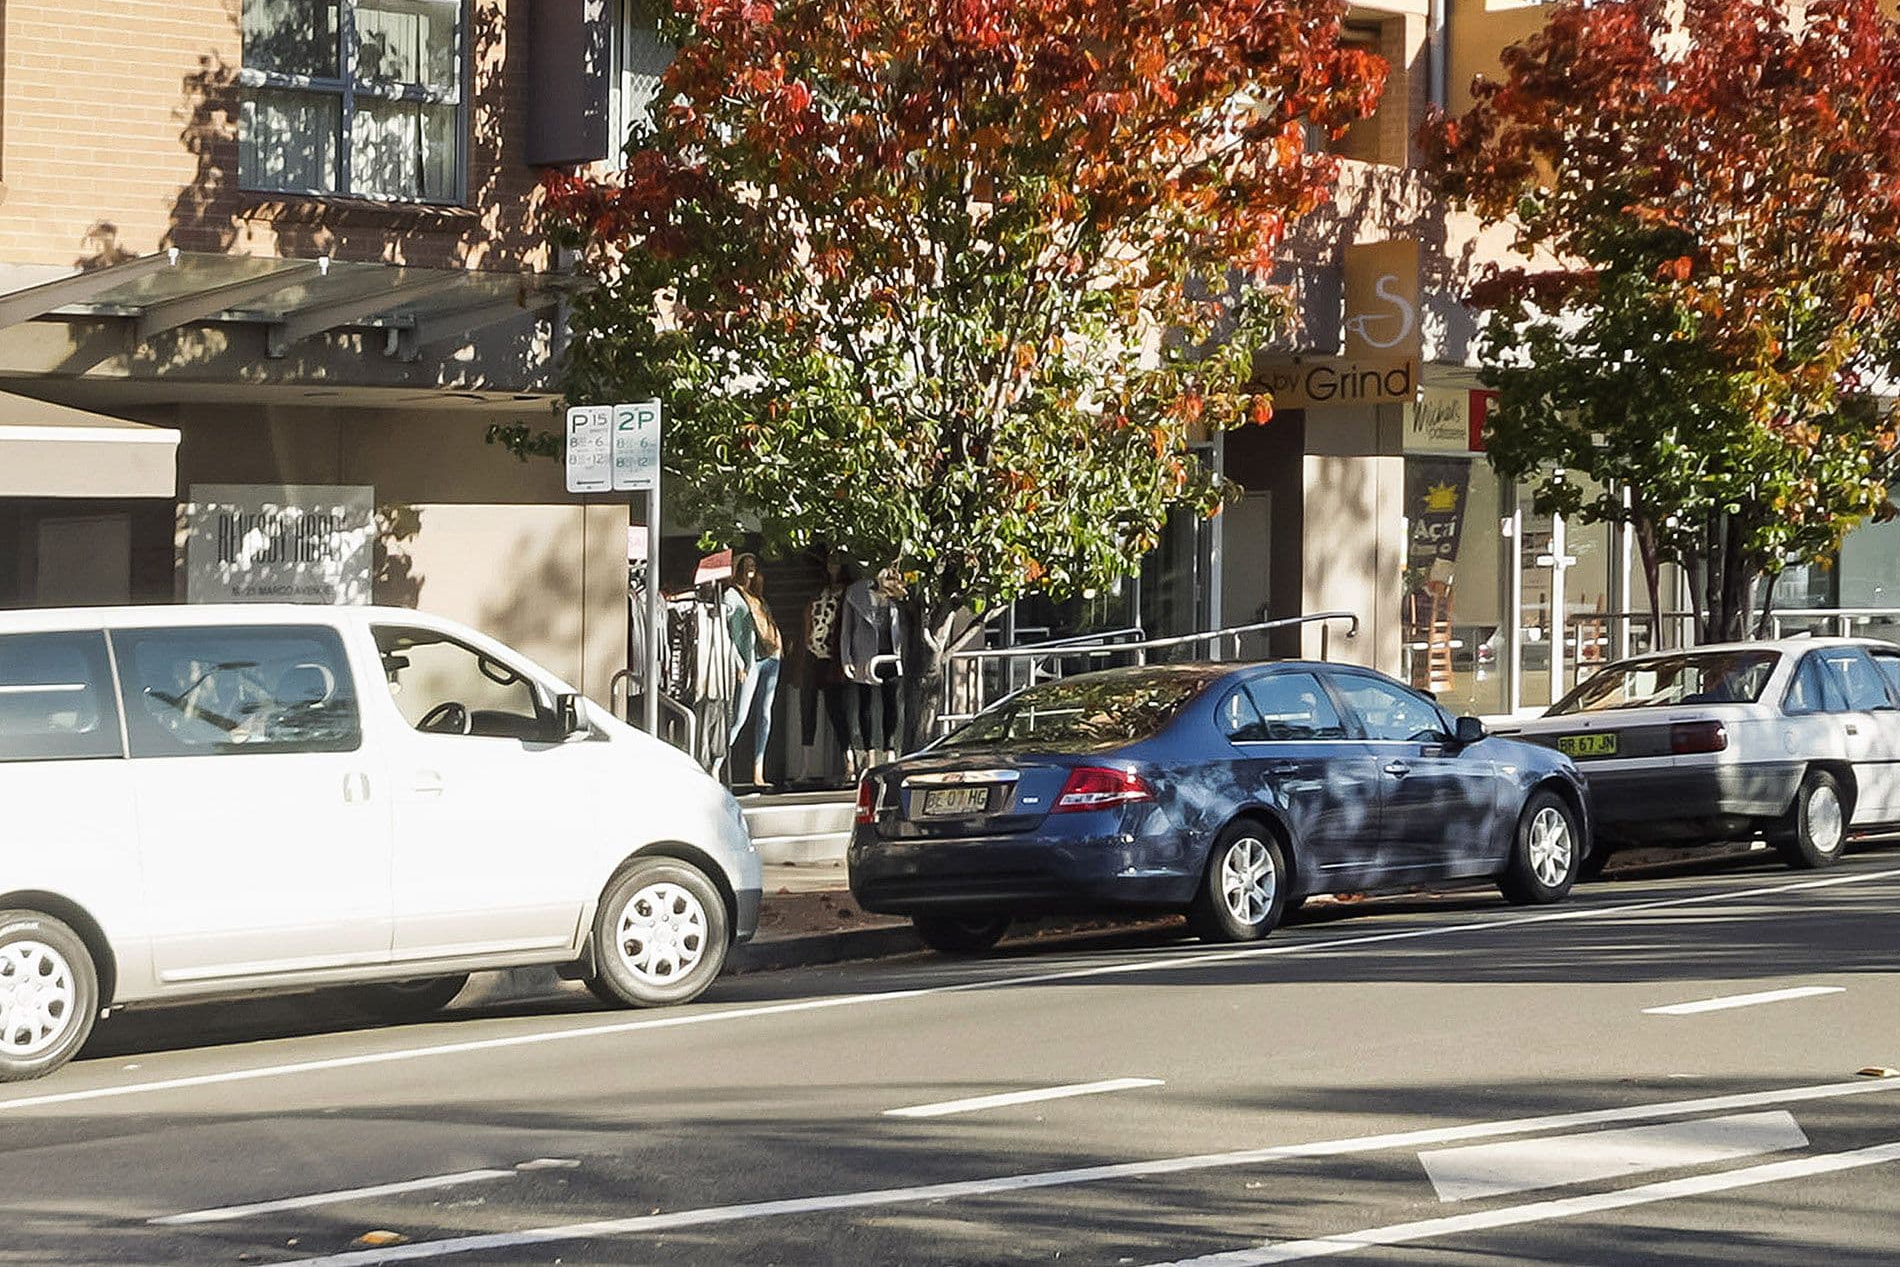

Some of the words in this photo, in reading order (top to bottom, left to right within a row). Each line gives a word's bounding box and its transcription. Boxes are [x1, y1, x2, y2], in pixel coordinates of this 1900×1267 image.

[1304, 363, 1410, 402] Grind
[572, 415, 588, 434] P
[593, 413, 607, 426] 15
[618, 410, 655, 431] 2P
